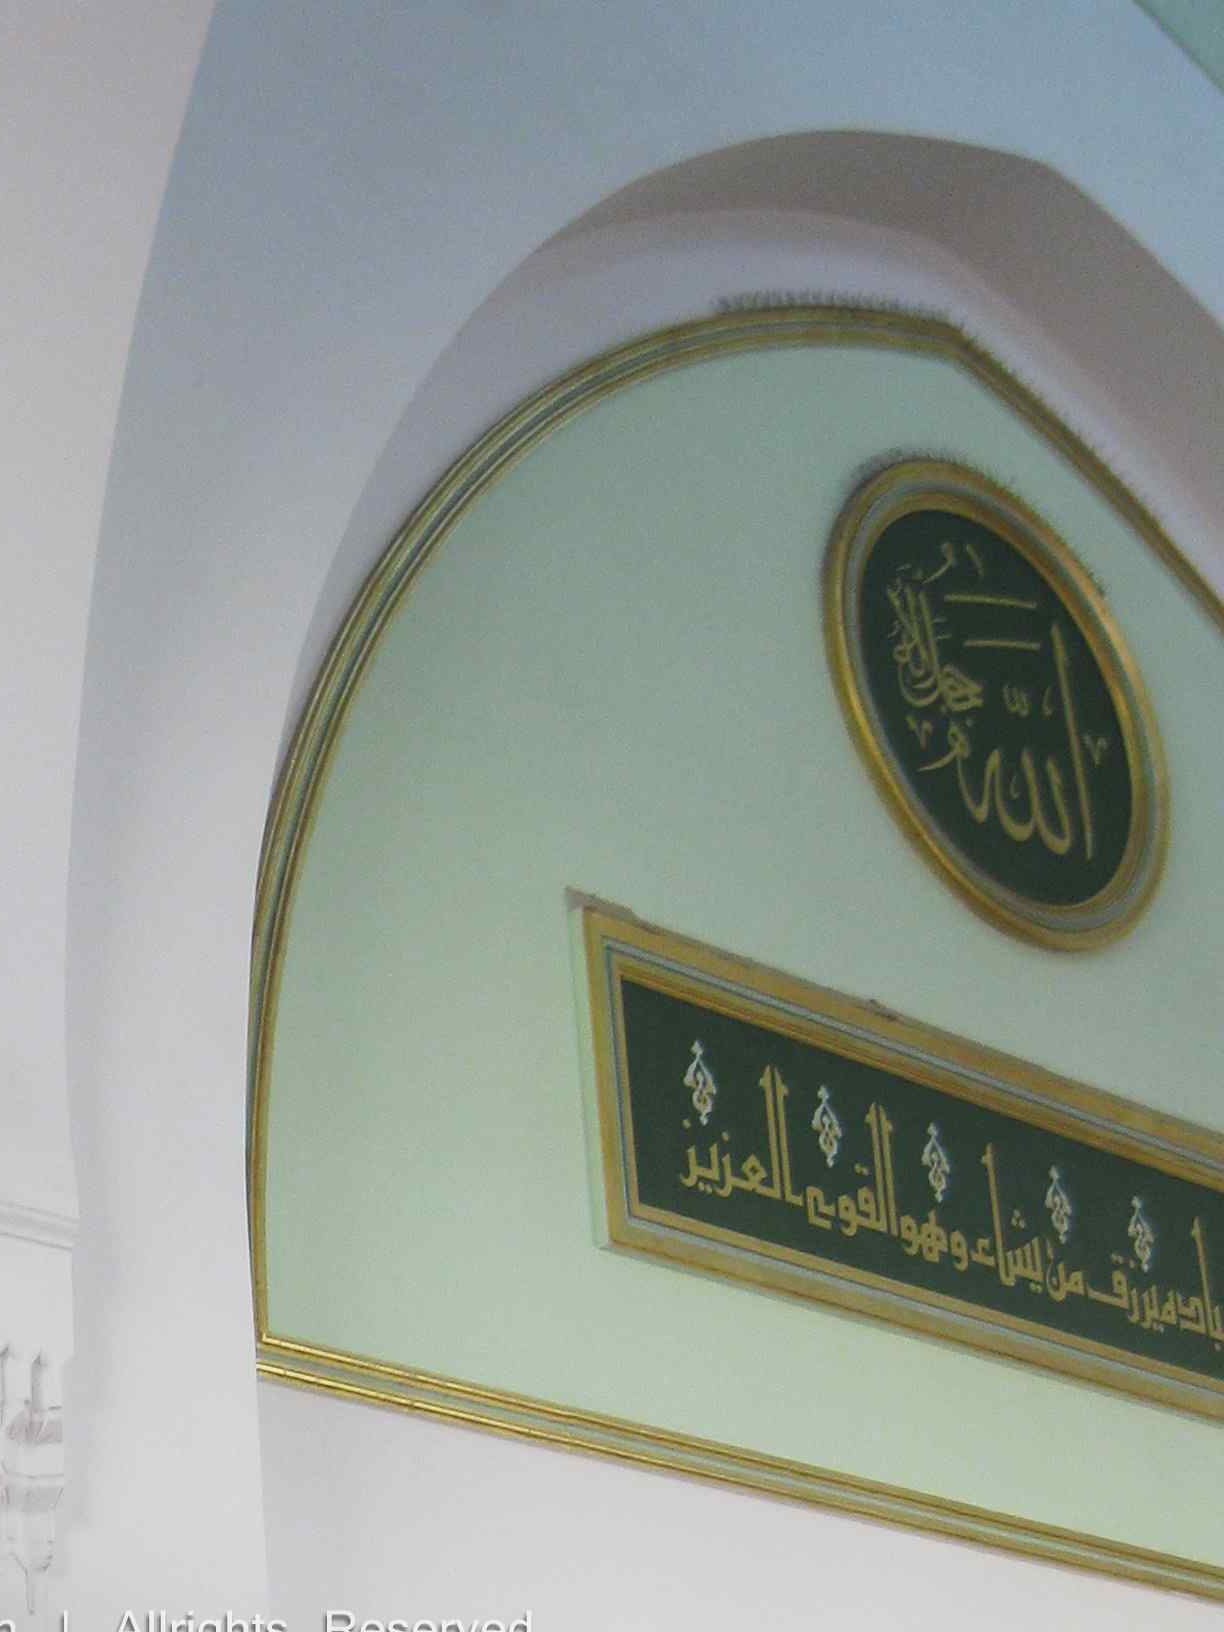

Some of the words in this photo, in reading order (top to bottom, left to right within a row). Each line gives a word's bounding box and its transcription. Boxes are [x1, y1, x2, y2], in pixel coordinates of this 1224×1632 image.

[918, 620, 1094, 862] الله
[680, 1064, 804, 1202] العزيز
[900, 1210, 969, 1271] وهو
[970, 1143, 1045, 1294] يشاء
[1046, 1238, 1085, 1302] من
